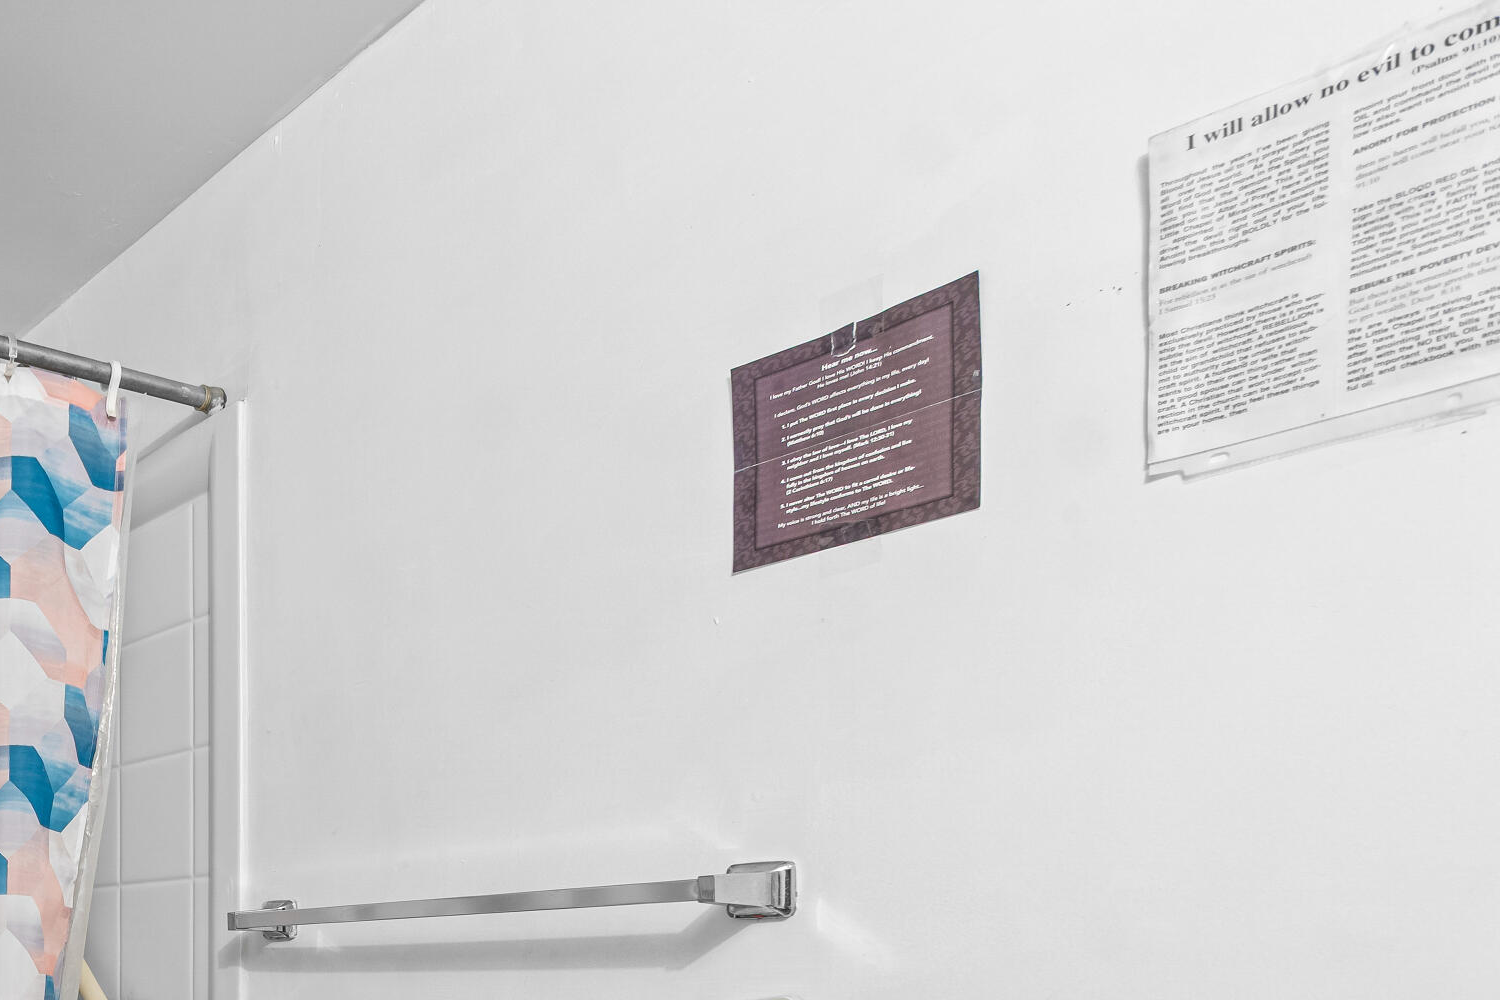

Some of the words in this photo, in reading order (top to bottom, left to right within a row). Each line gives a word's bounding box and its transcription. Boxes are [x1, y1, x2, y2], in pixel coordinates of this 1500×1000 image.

[1411, 53, 1458, 75] (Psalms
[1186, 134, 1196, 151] I
[1204, 117, 1243, 143] will
[1250, 93, 1312, 128] allow
[1320, 79, 1349, 99] no
[1357, 52, 1400, 83] evil
[1410, 46, 1435, 61] to
[1160, 167, 1207, 189] Throughout
[1211, 161, 1225, 170] the
[1229, 152, 1252, 164] years
[1275, 133, 1297, 145] been
[1302, 120, 1330, 136] giving
[1160, 182, 1183, 196] Blood
[1197, 170, 1221, 183] Jesus
[1224, 163, 1234, 172] oil
[1247, 156, 1259, 165] my
[1261, 145, 1288, 160] prayer
[1292, 128, 1329, 147] partners
[1159, 273, 1207, 295] BREAKING
[1210, 254, 1271, 279] WITCHCRAFT
[1158, 329, 1178, 340] Most
[1180, 316, 1222, 334] Christians
[1224, 309, 1244, 320] think
[1247, 295, 1289, 313] witchcraft
[1158, 329, 1203, 348] exclusively
[1205, 317, 1243, 334] practiced
[1246, 313, 1256, 322] by
[1258, 305, 1281, 316] those
[1284, 298, 1302, 308] who
[1157, 412, 1197, 429] witchcraft
[1232, 400, 1246, 409] you
[1248, 394, 1264, 403] feel
[1266, 387, 1289, 398] these
[1292, 378, 1319, 392] things
[1182, 421, 1199, 430] your
[1229, 407, 1247, 416] then
